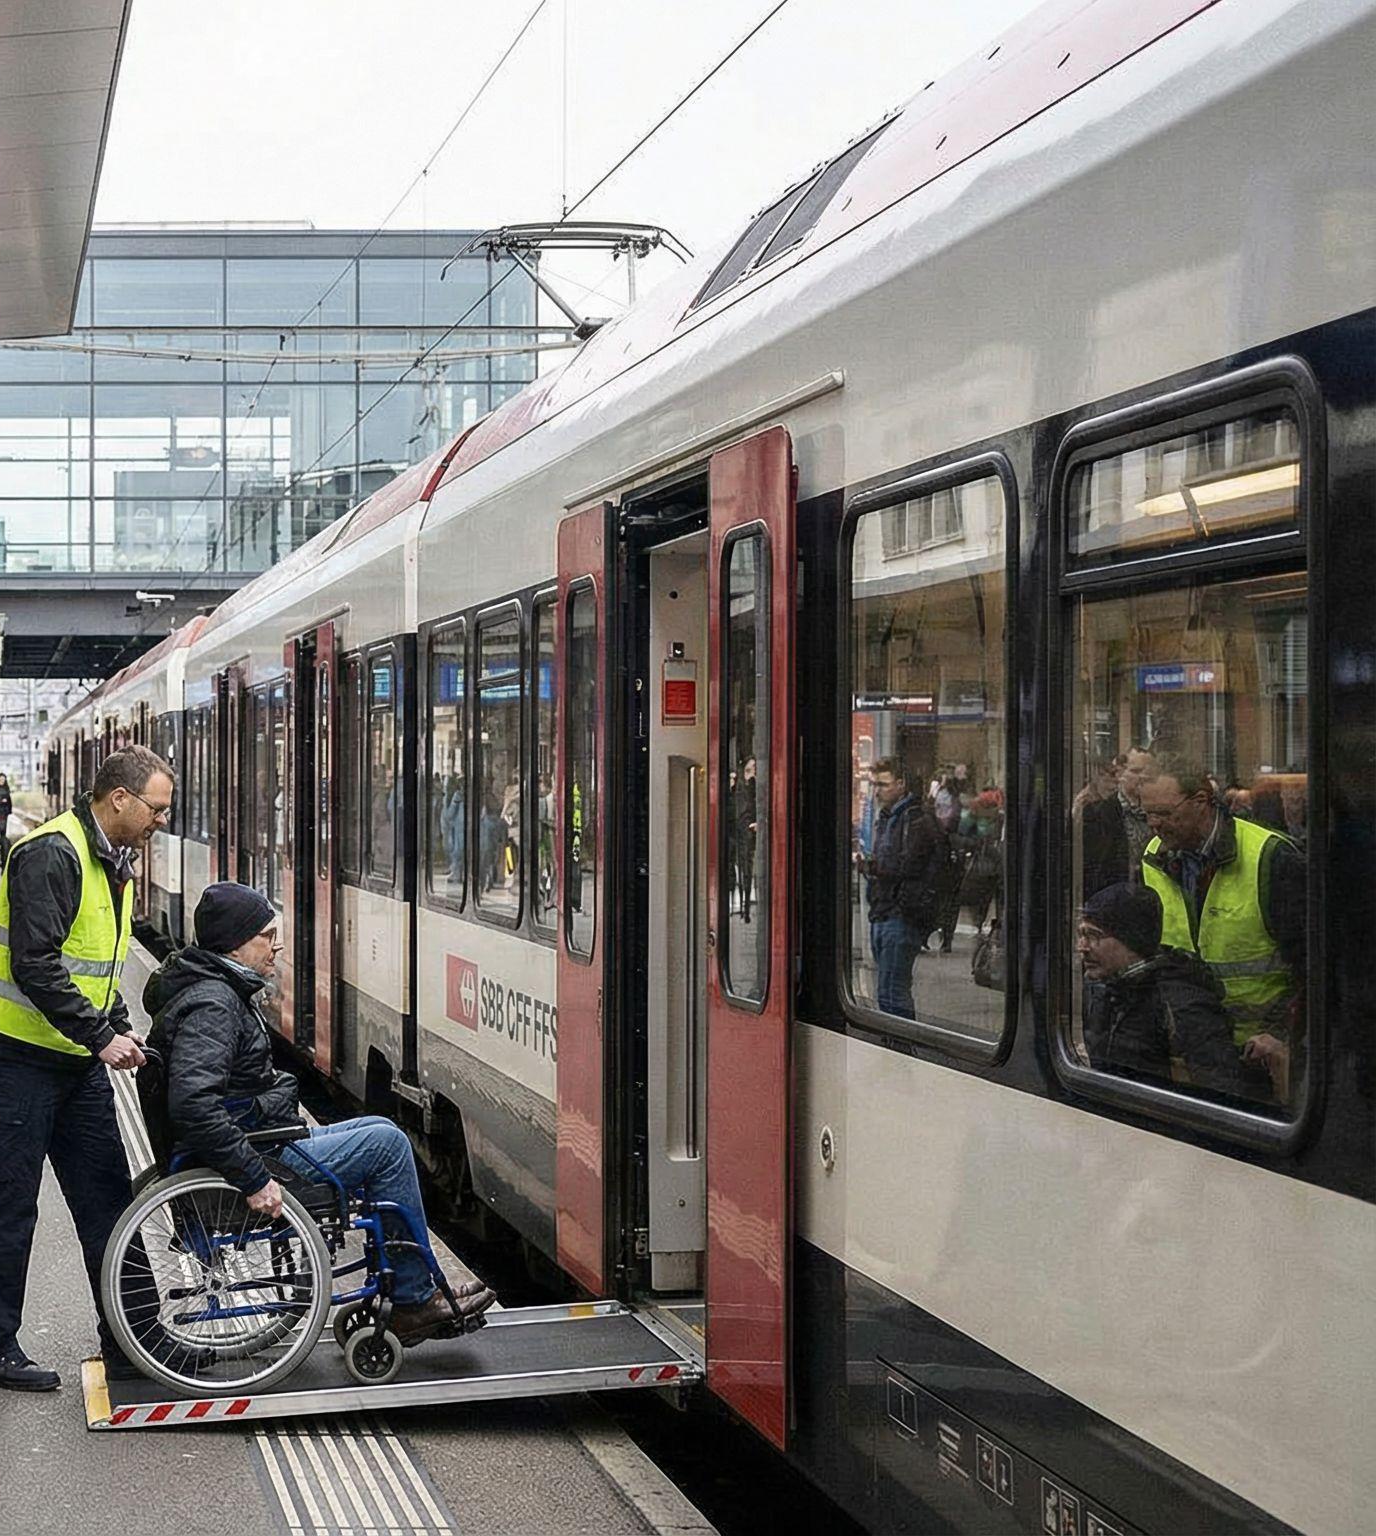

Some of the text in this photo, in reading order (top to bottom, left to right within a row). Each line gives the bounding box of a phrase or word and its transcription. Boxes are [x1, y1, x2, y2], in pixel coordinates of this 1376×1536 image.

[481, 976, 558, 1063] SBB CFF FFS
